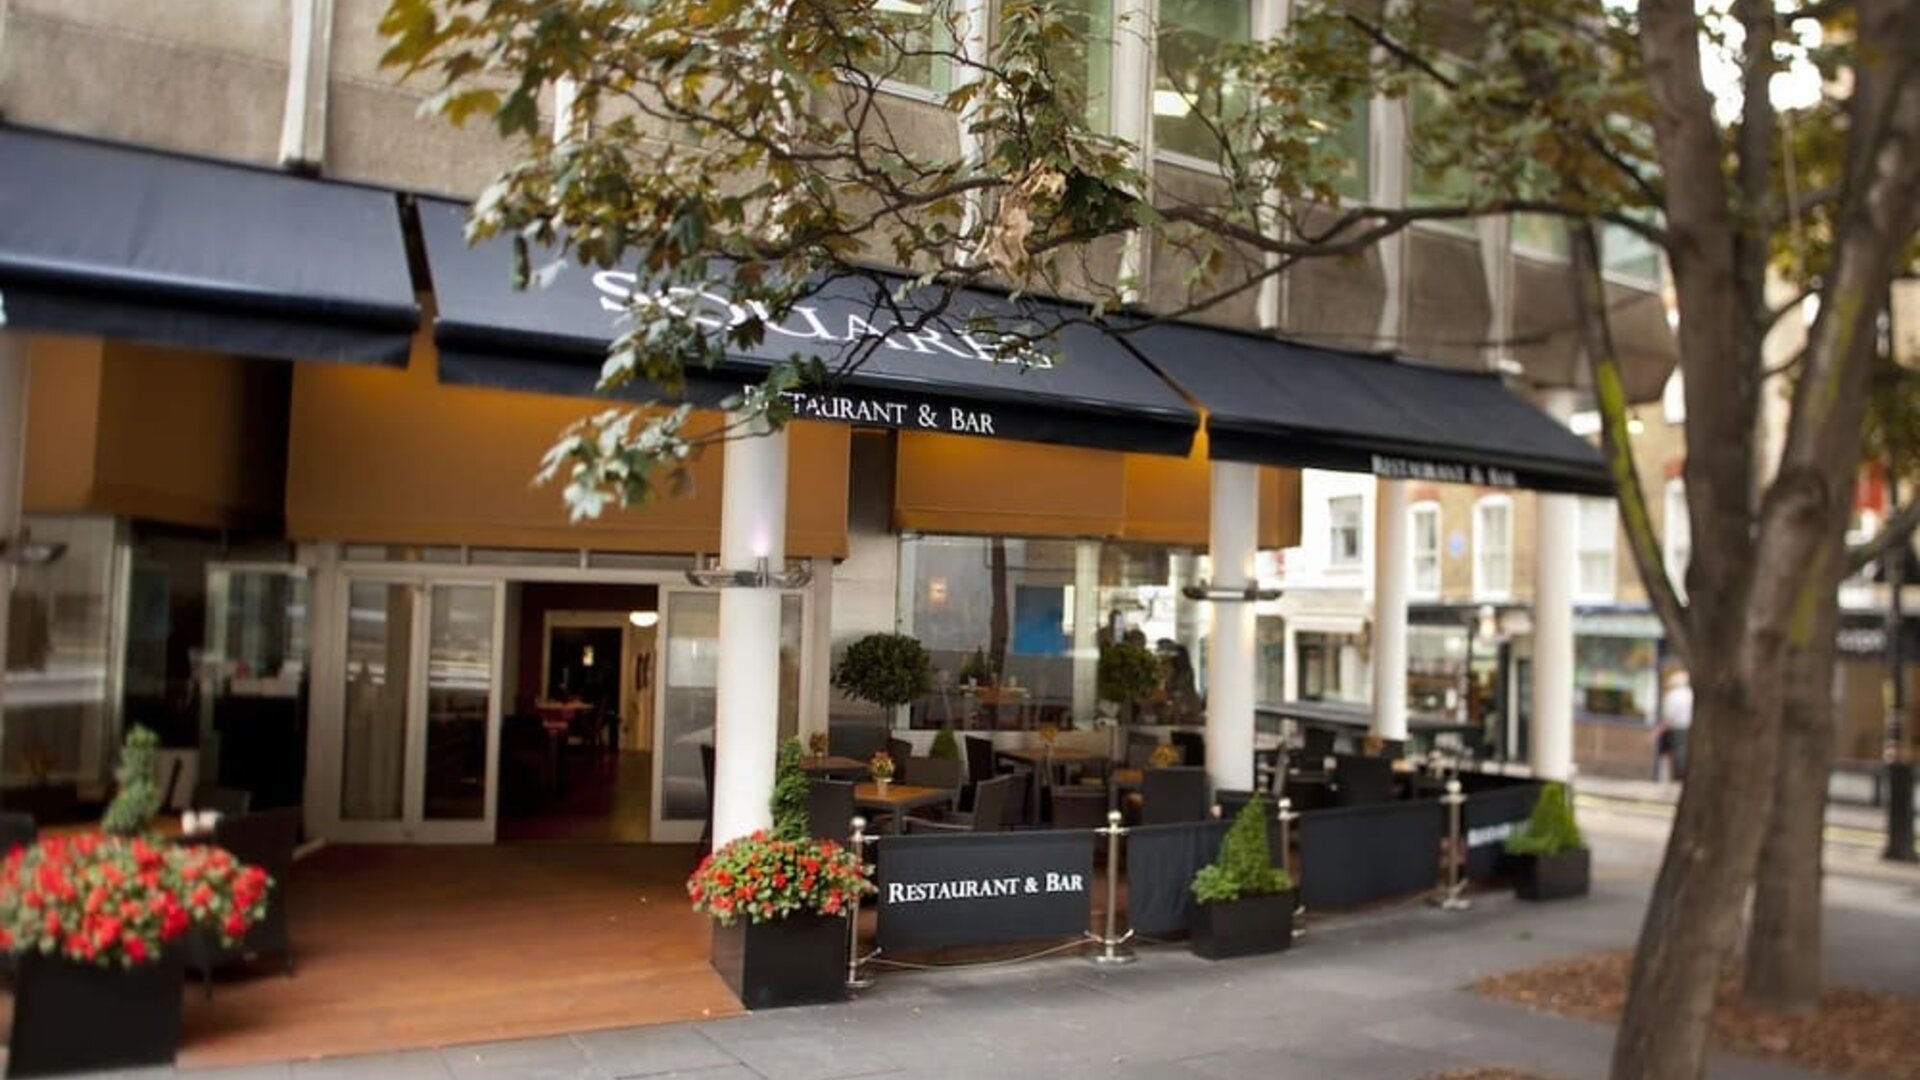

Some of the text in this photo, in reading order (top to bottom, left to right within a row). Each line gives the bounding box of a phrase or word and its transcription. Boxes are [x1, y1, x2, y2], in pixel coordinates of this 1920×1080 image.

[743, 384, 996, 435] RTAURANT & BAR
[888, 871, 1084, 904] RESTAURANT & BAR
